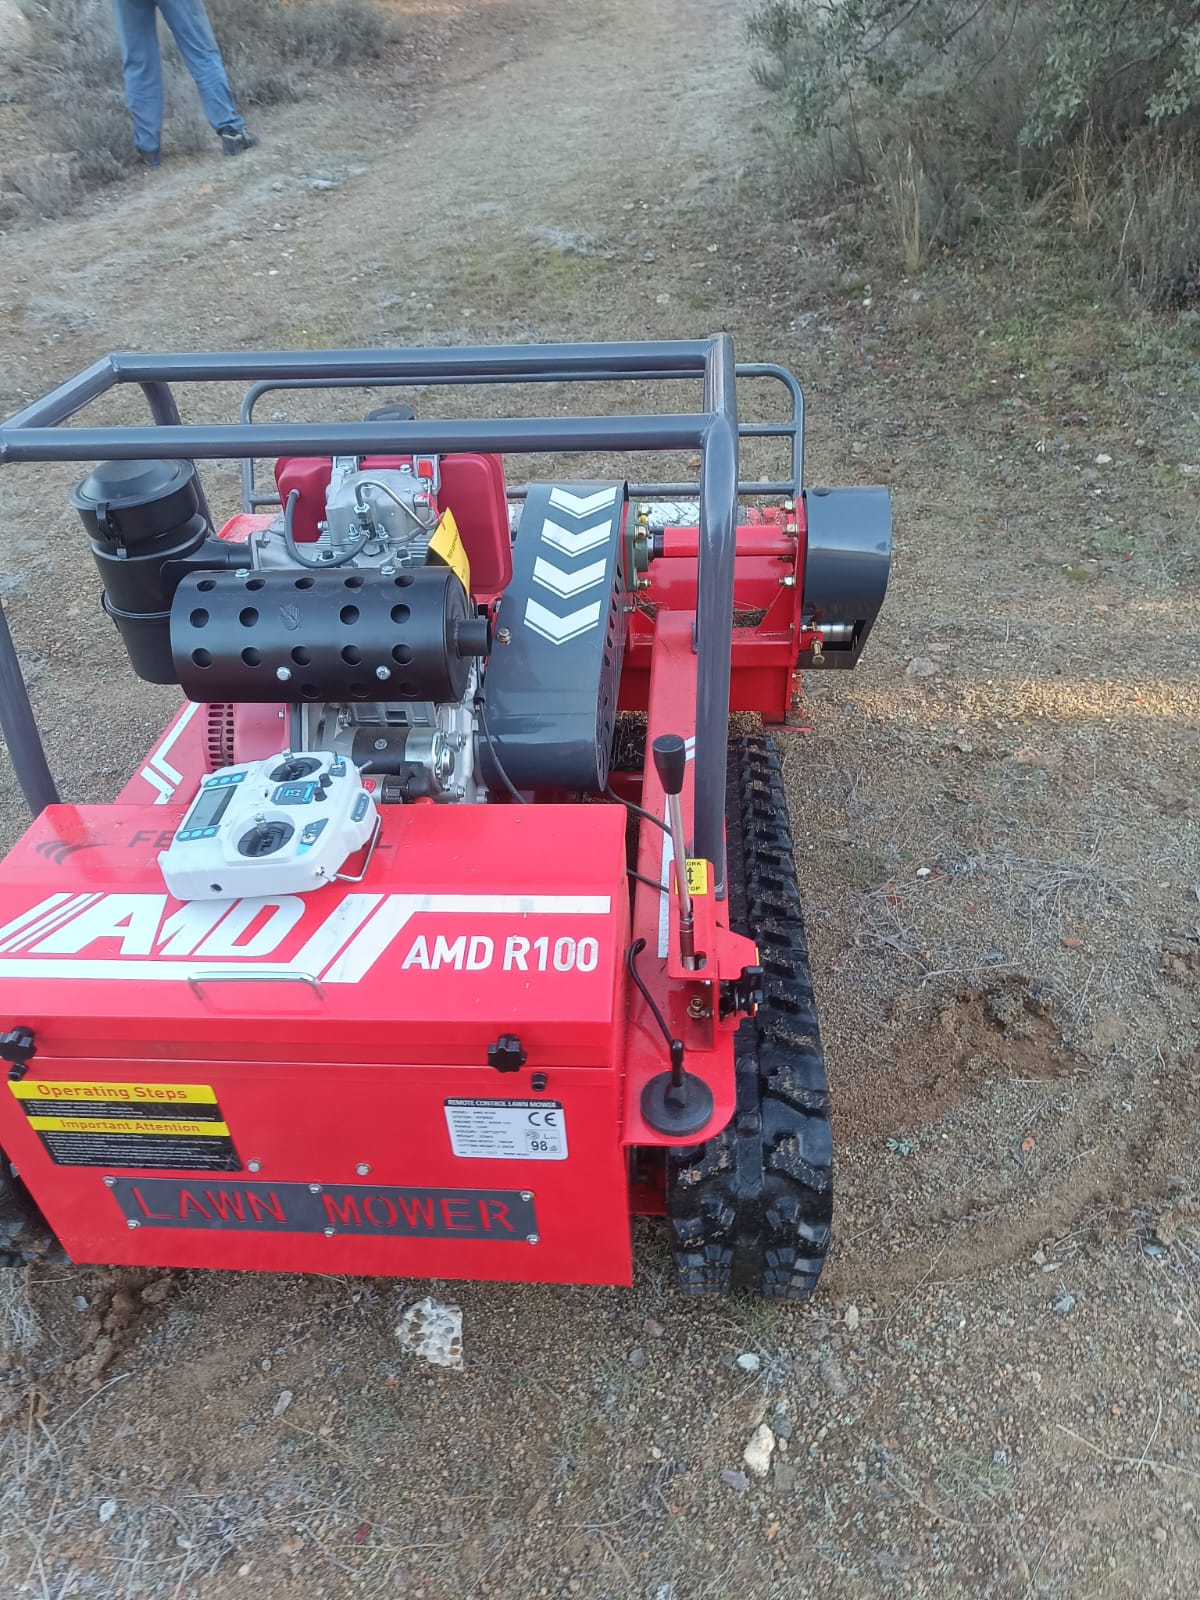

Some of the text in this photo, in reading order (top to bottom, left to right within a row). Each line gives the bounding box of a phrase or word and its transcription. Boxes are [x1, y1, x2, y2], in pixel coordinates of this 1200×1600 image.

[401, 934, 600, 973] AMD R100
[37, 1084, 188, 1101] Operating Steps
[60, 1119, 200, 1133] Important Attention
[531, 1140, 548, 1151] 98
[131, 1187, 517, 1233] LAWN MOWER
